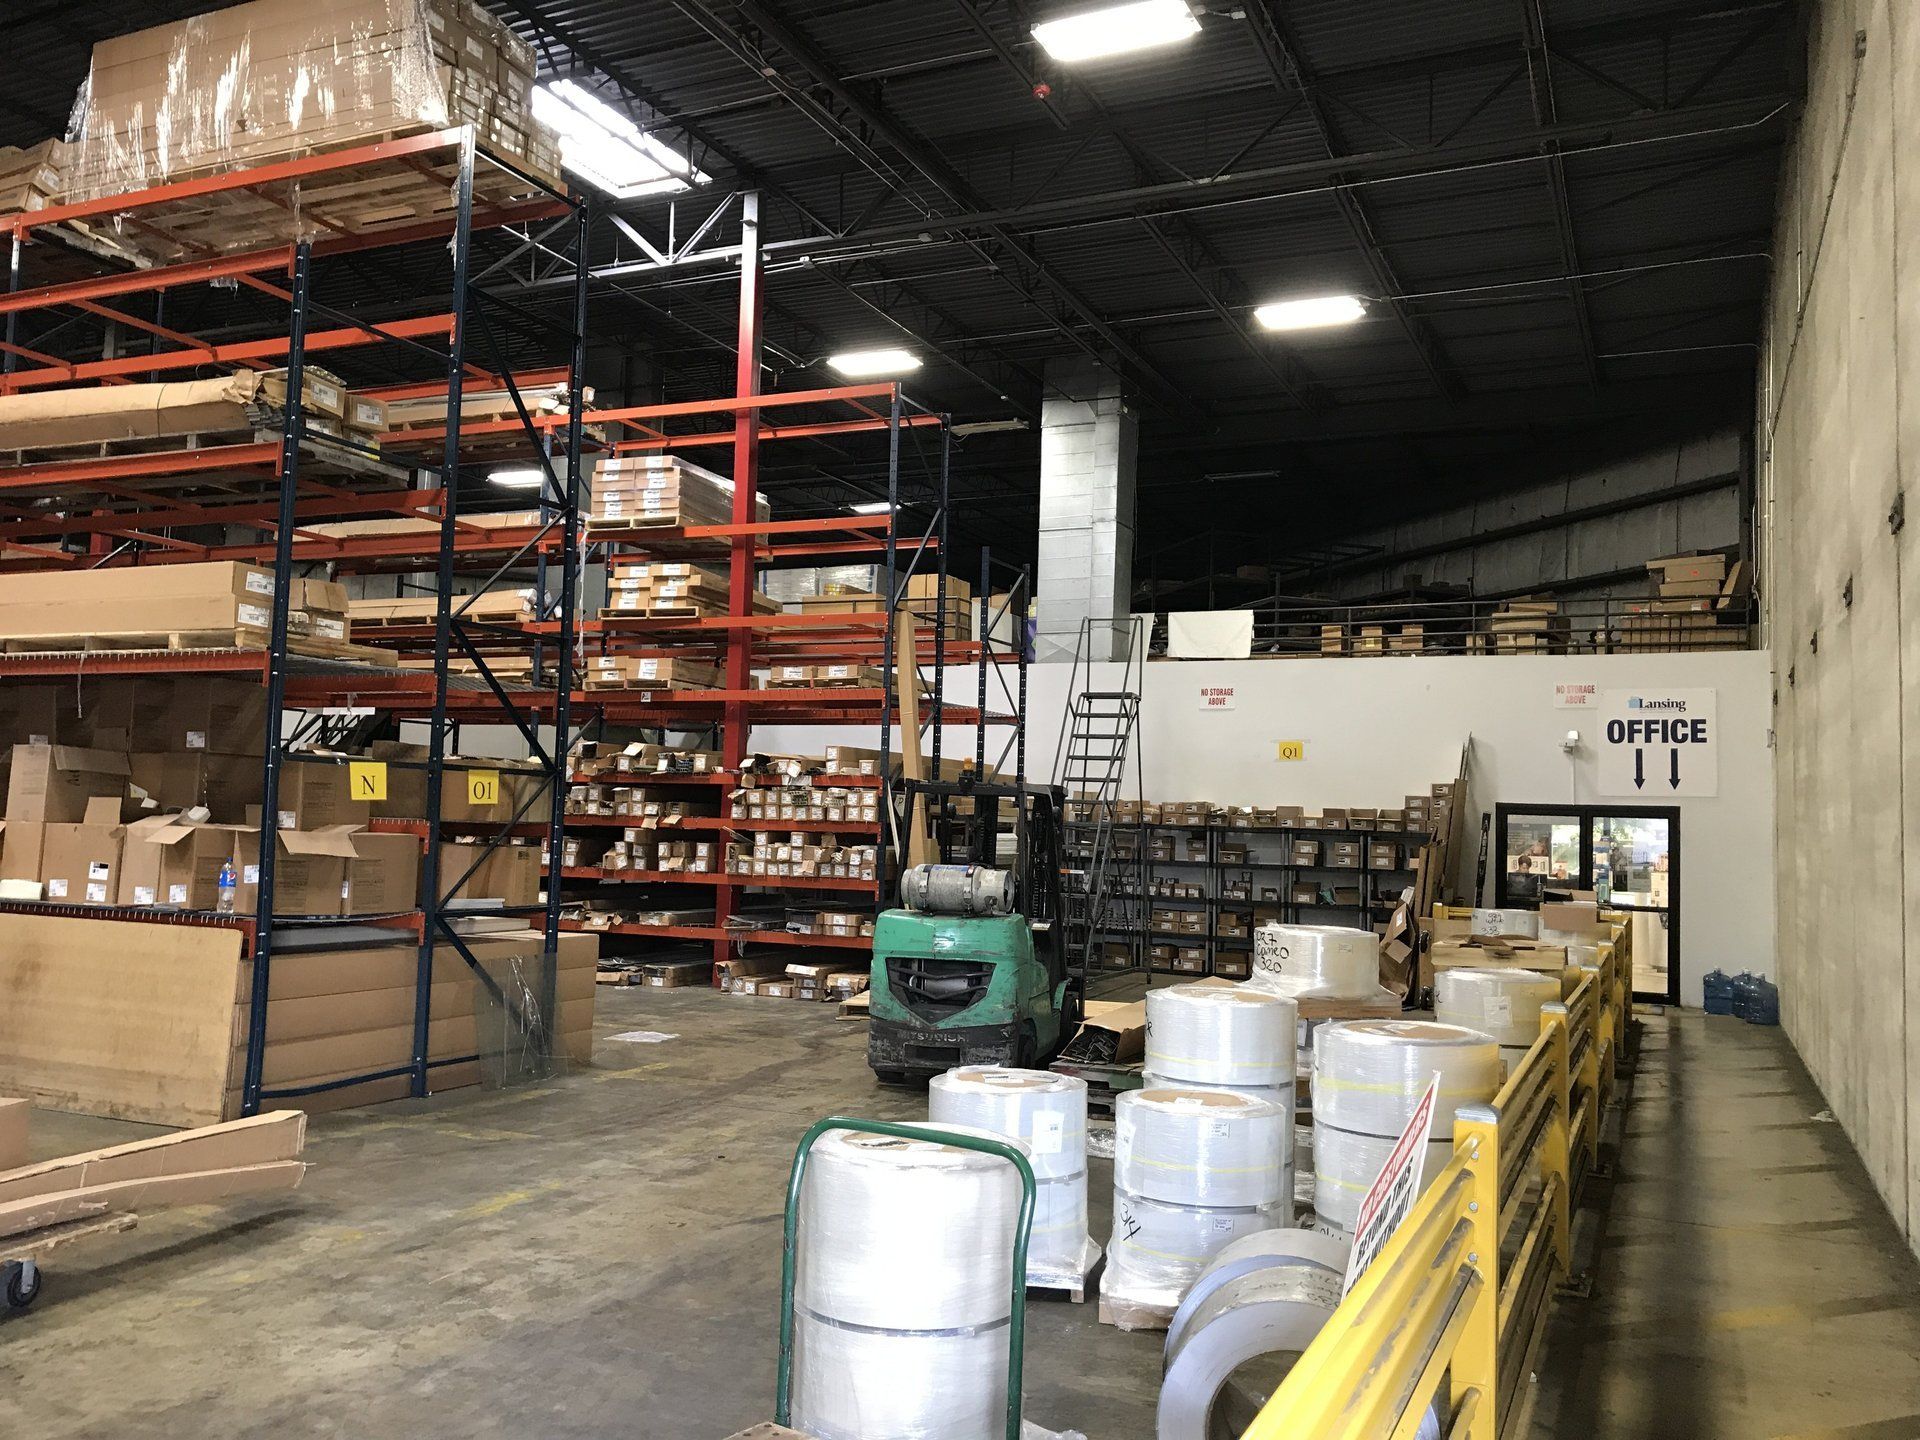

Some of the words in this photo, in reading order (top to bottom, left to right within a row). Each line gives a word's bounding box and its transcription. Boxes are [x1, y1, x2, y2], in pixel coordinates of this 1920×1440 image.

[1201, 688, 1209, 696] NO
[1210, 688, 1234, 696] STORAGE
[1556, 685, 1565, 694] NO
[1566, 684, 1596, 694] STORAGE
[1208, 697, 1226, 705] ABOVE
[1565, 695, 1586, 704] ABOVE
[1638, 698, 1687, 713] Lansing
[1607, 719, 1708, 744] OFFICE
[1282, 747, 1297, 760] Q1
[361, 775, 376, 795] N
[1260, 956, 1283, 974] 320
[1390, 1154, 1414, 1210] THIS
